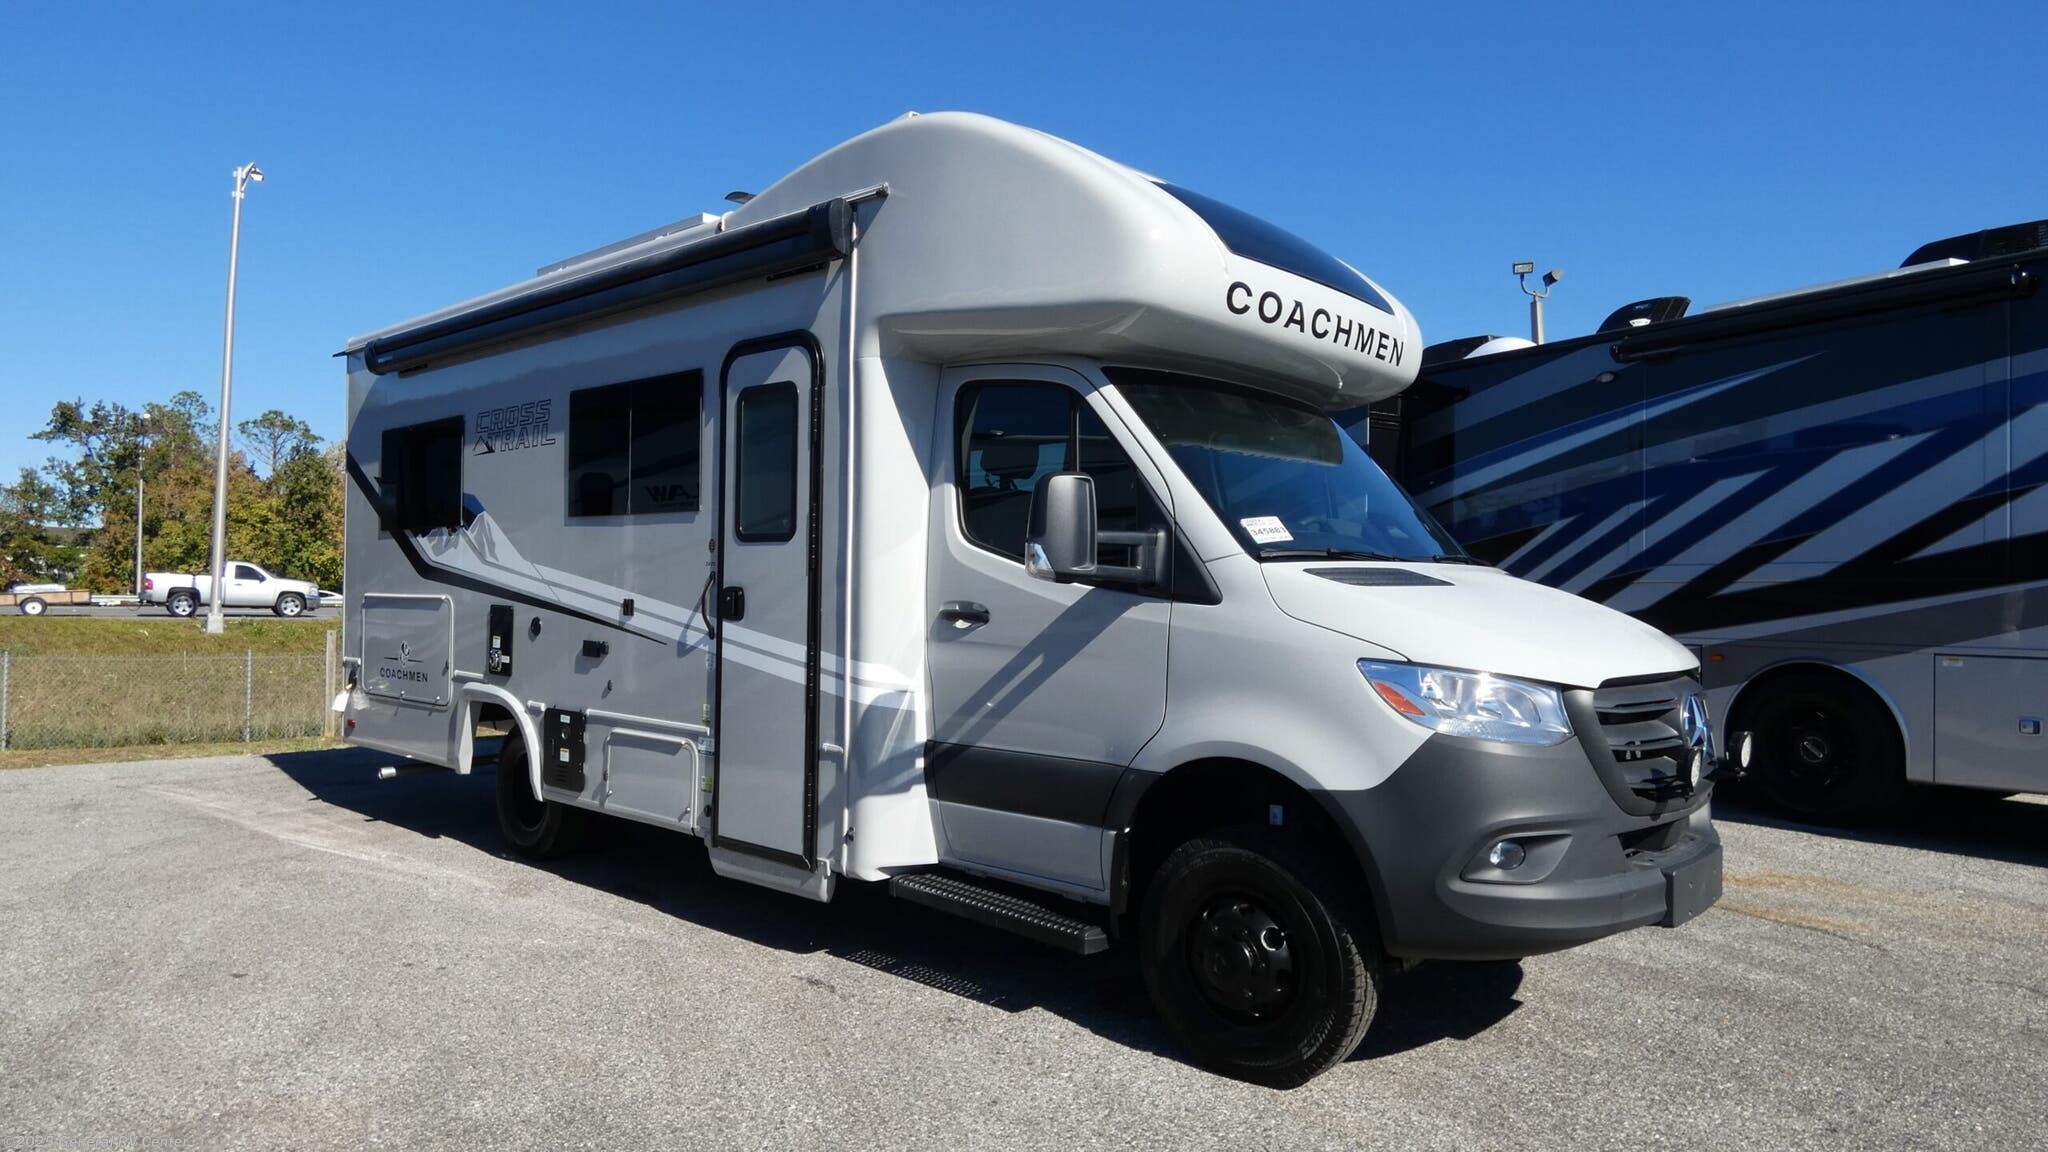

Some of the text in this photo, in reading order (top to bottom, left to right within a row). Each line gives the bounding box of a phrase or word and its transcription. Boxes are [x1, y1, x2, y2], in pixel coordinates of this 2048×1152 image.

[1226, 281, 1404, 367] COACHMEN
[476, 399, 551, 434] CROSS
[488, 423, 556, 452] TRAIL
[380, 667, 428, 682] COACHMEN
